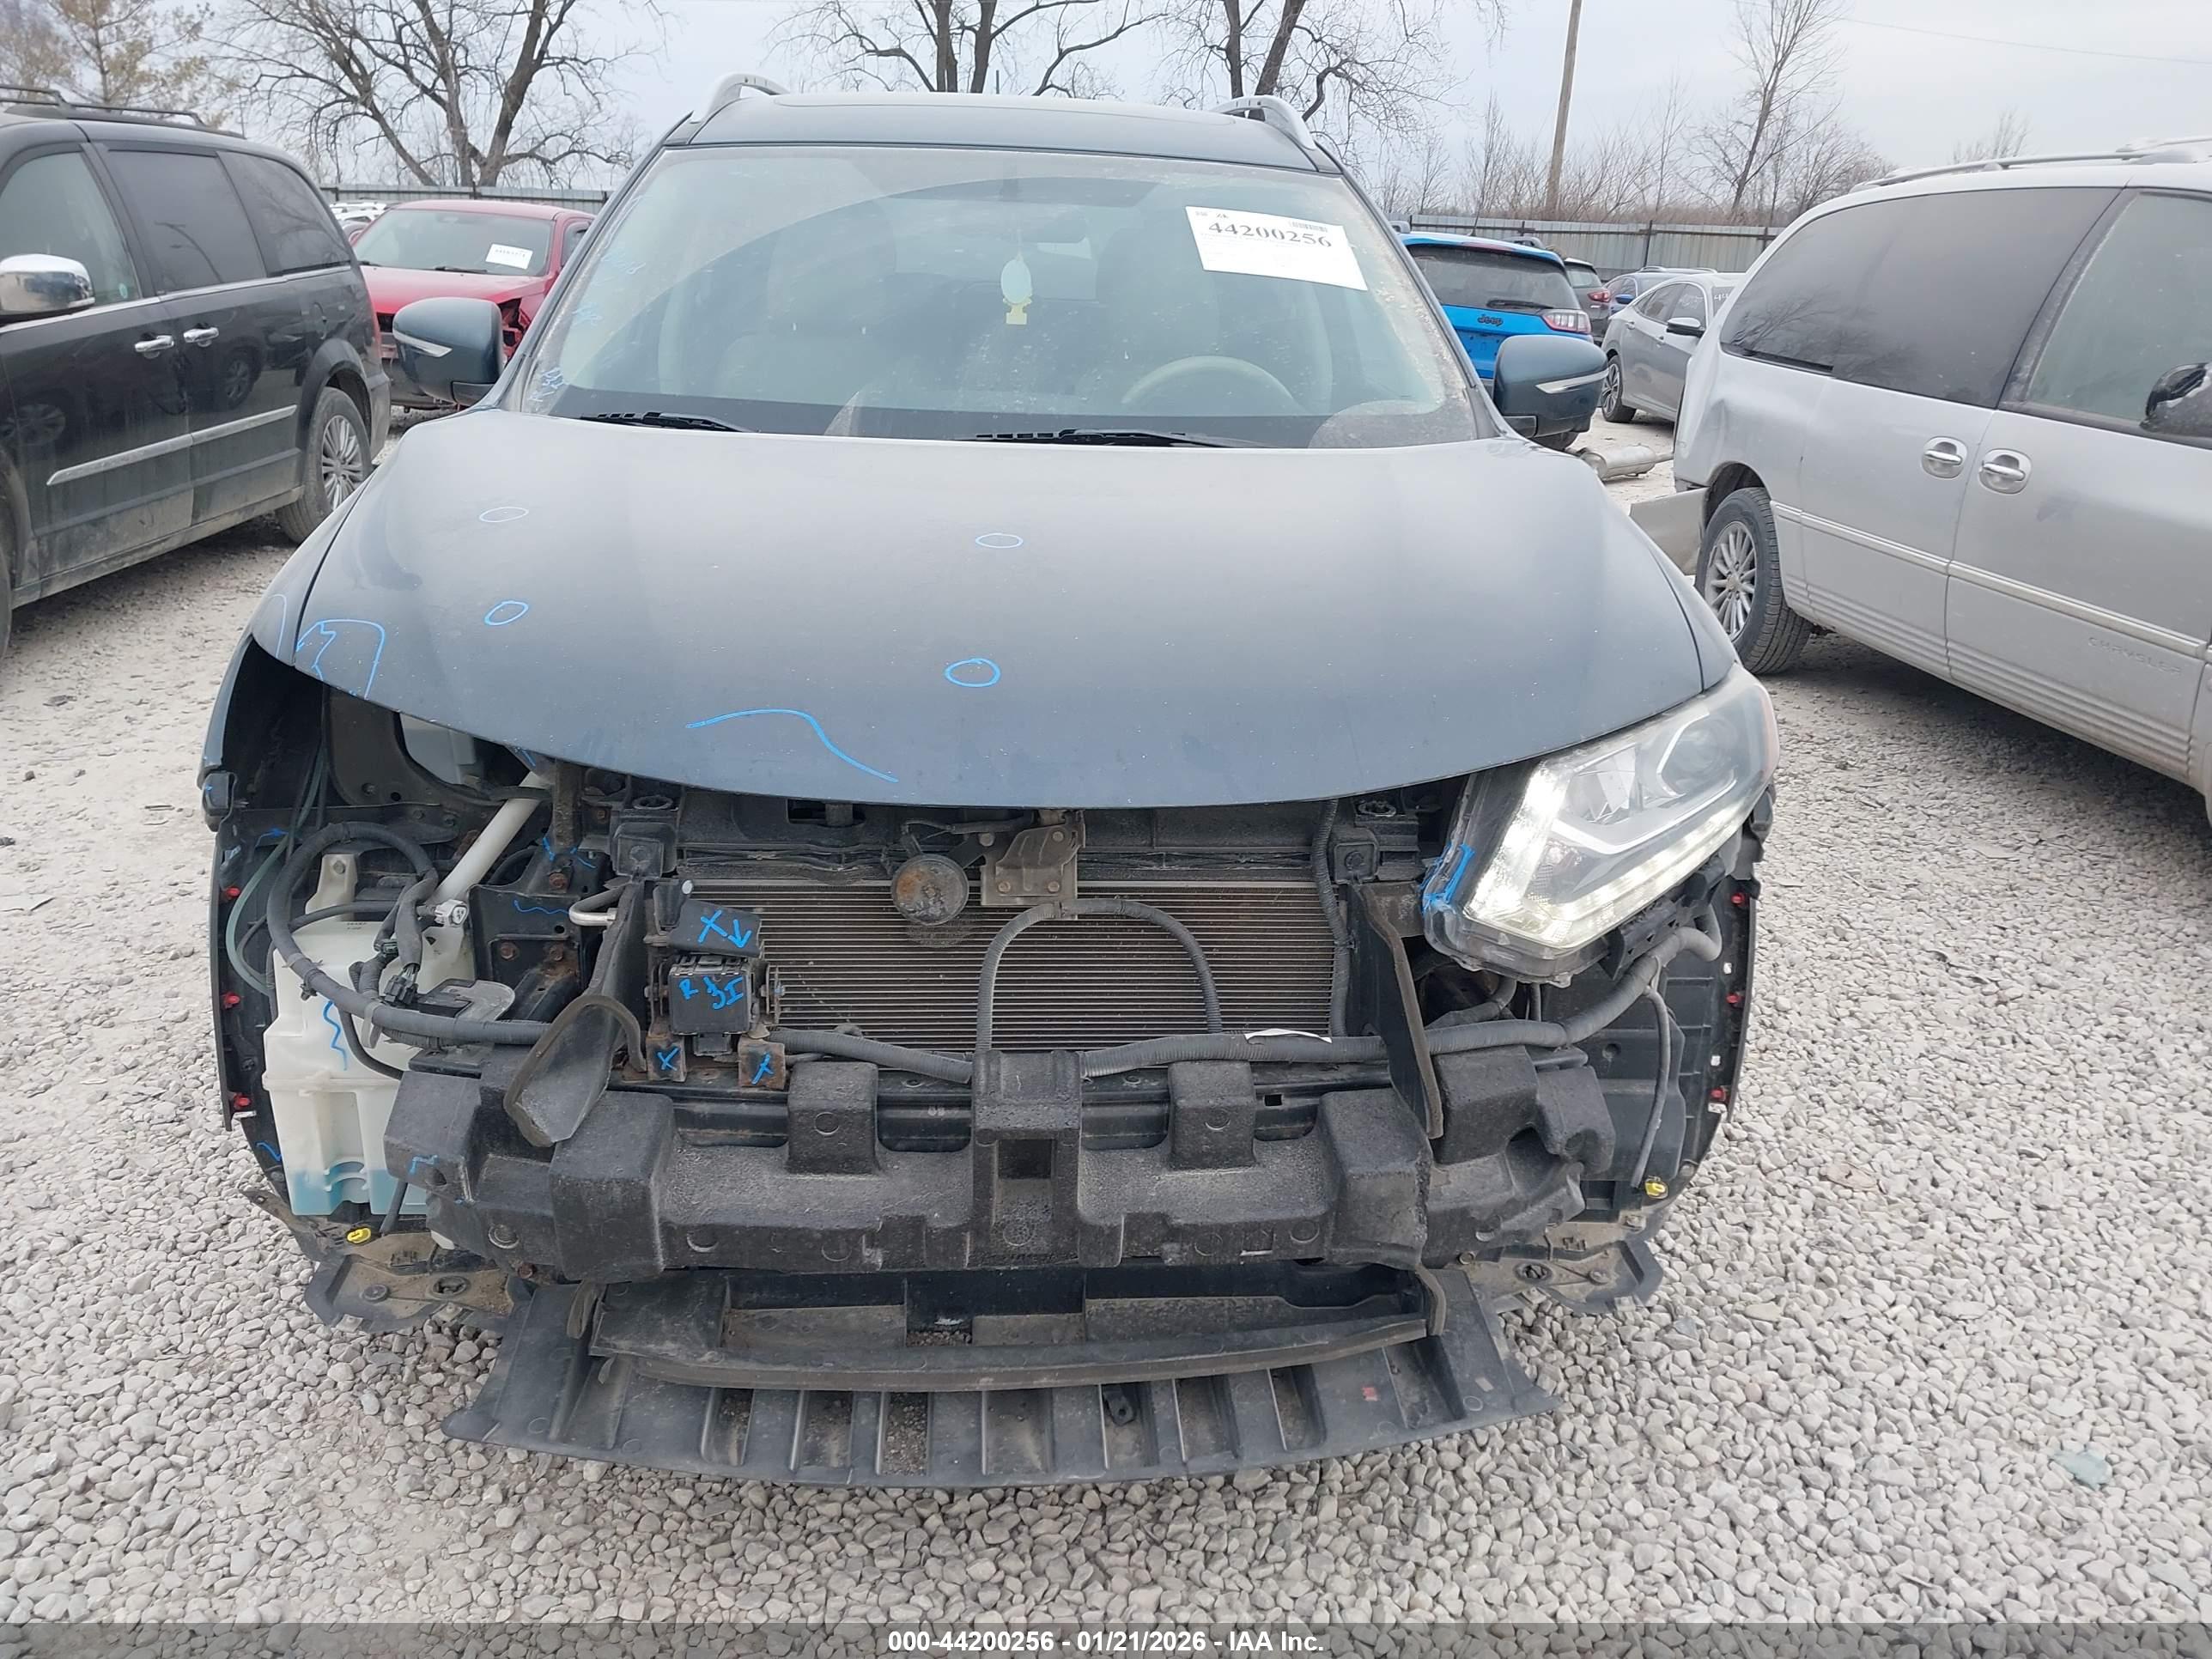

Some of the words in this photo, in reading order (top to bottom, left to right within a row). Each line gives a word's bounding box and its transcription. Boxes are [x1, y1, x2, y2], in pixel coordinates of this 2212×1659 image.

[1208, 222, 1332, 247] 44200256
[1477, 313, 1504, 327] Jeep
[2088, 637, 2181, 674] CHRYSLER
